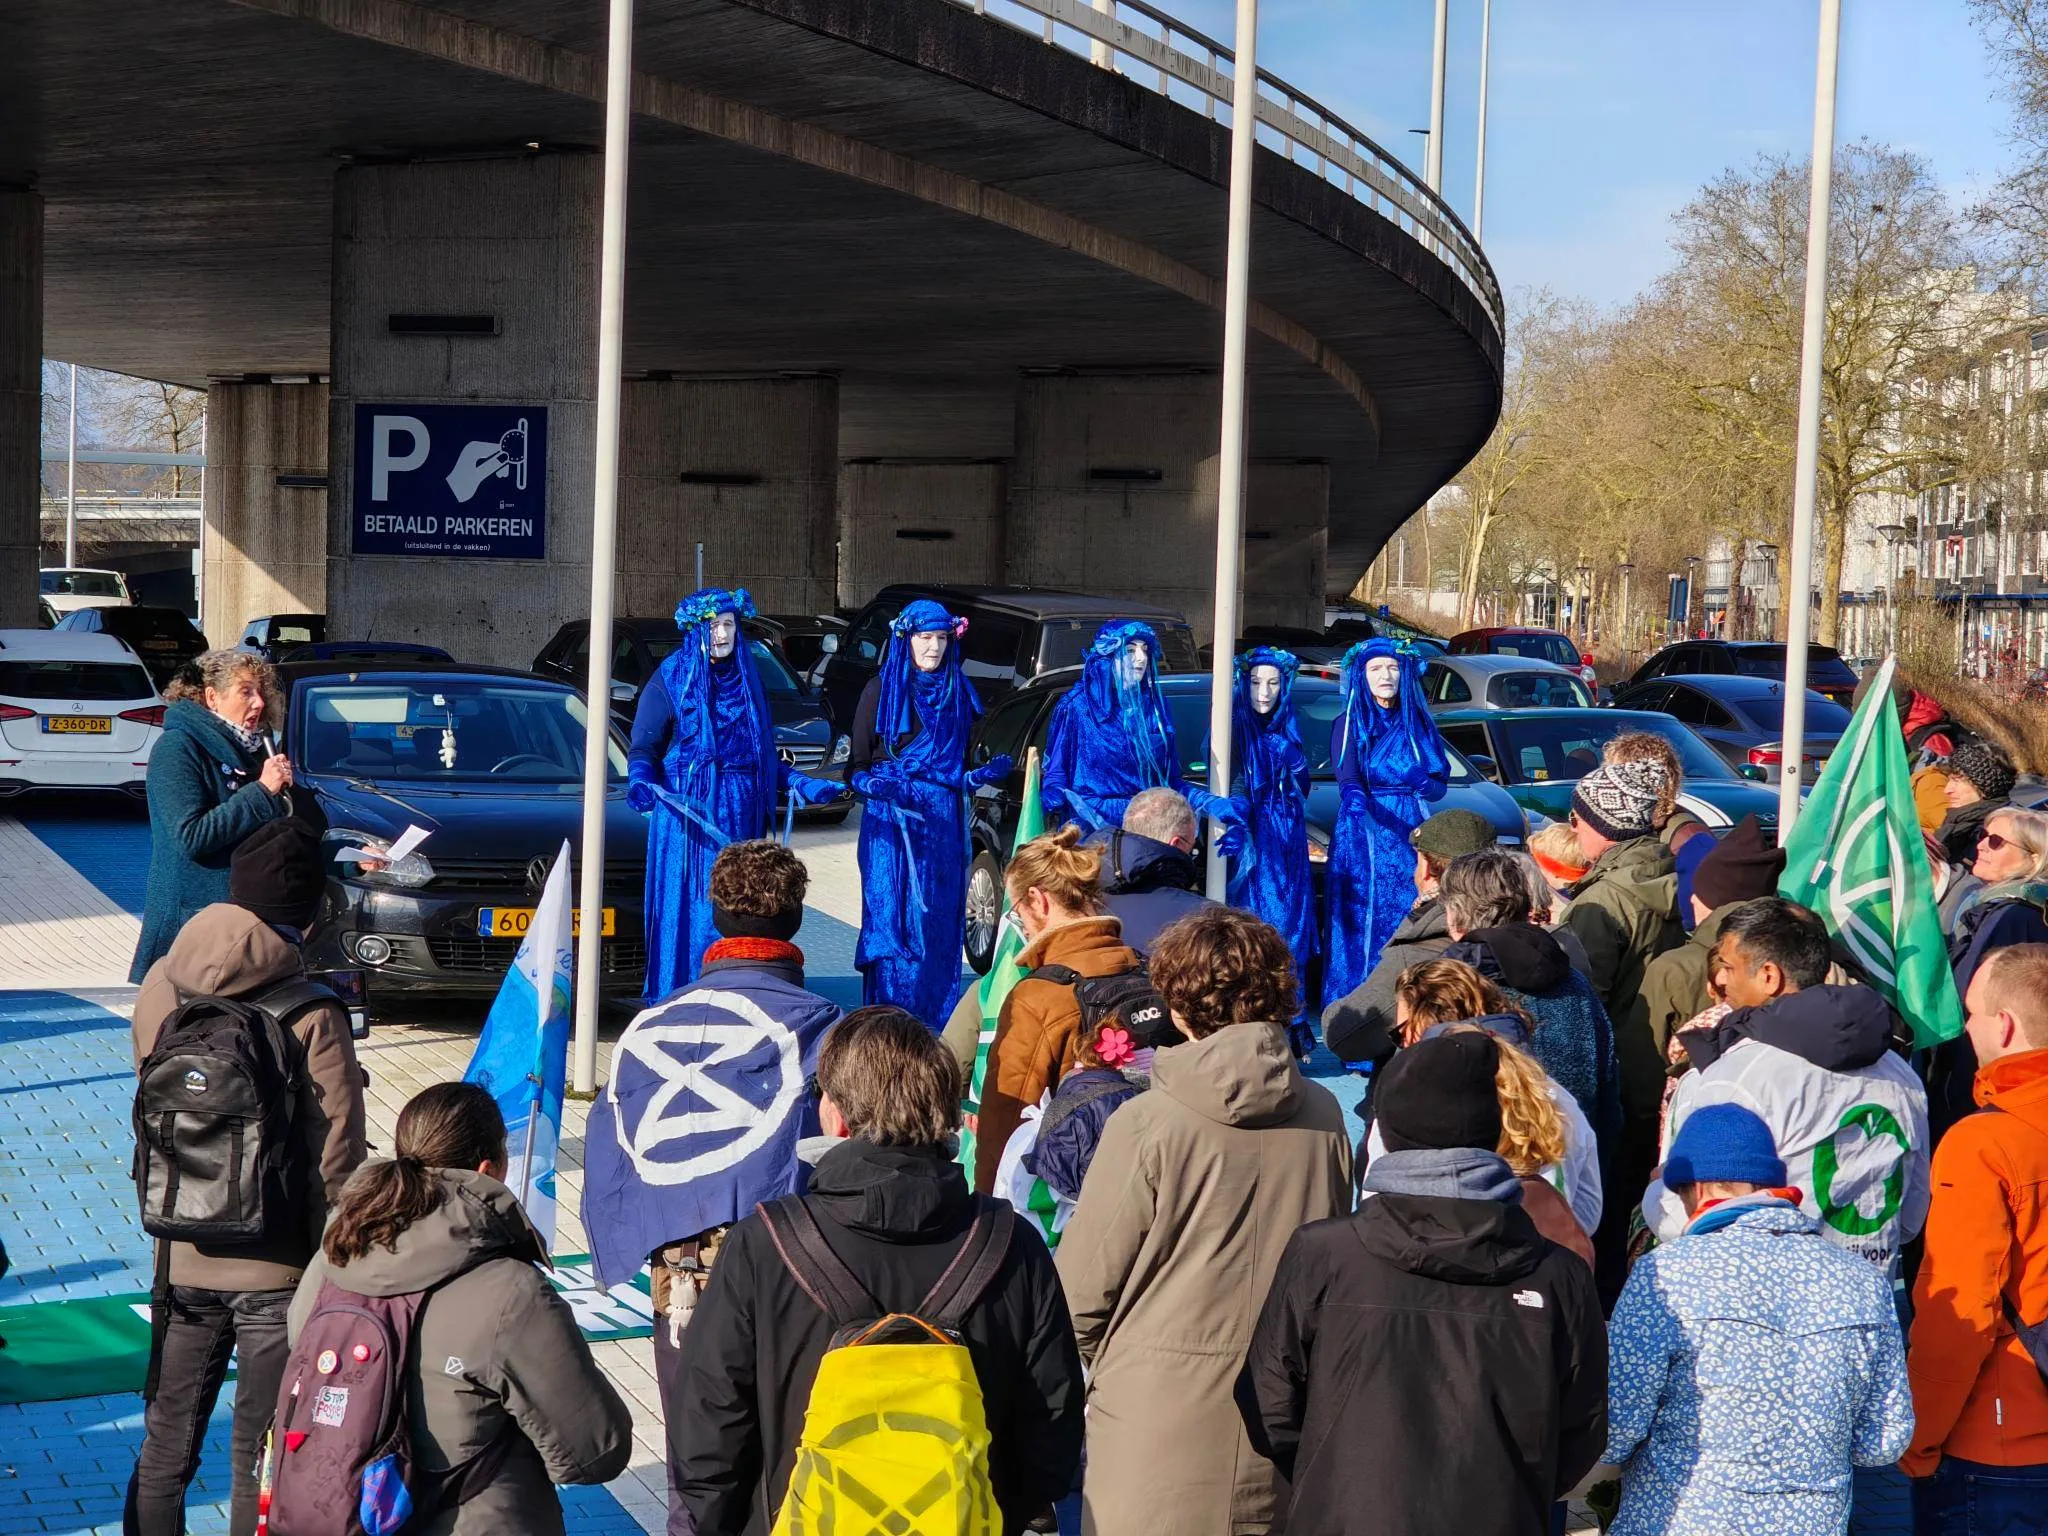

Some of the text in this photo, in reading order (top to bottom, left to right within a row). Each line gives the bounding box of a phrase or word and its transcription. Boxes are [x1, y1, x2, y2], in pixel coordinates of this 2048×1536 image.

[372, 415, 430, 501] P
[365, 515, 533, 537] BETAALD PARKEREN
[51, 719, 106, 730] Z-360-DR
